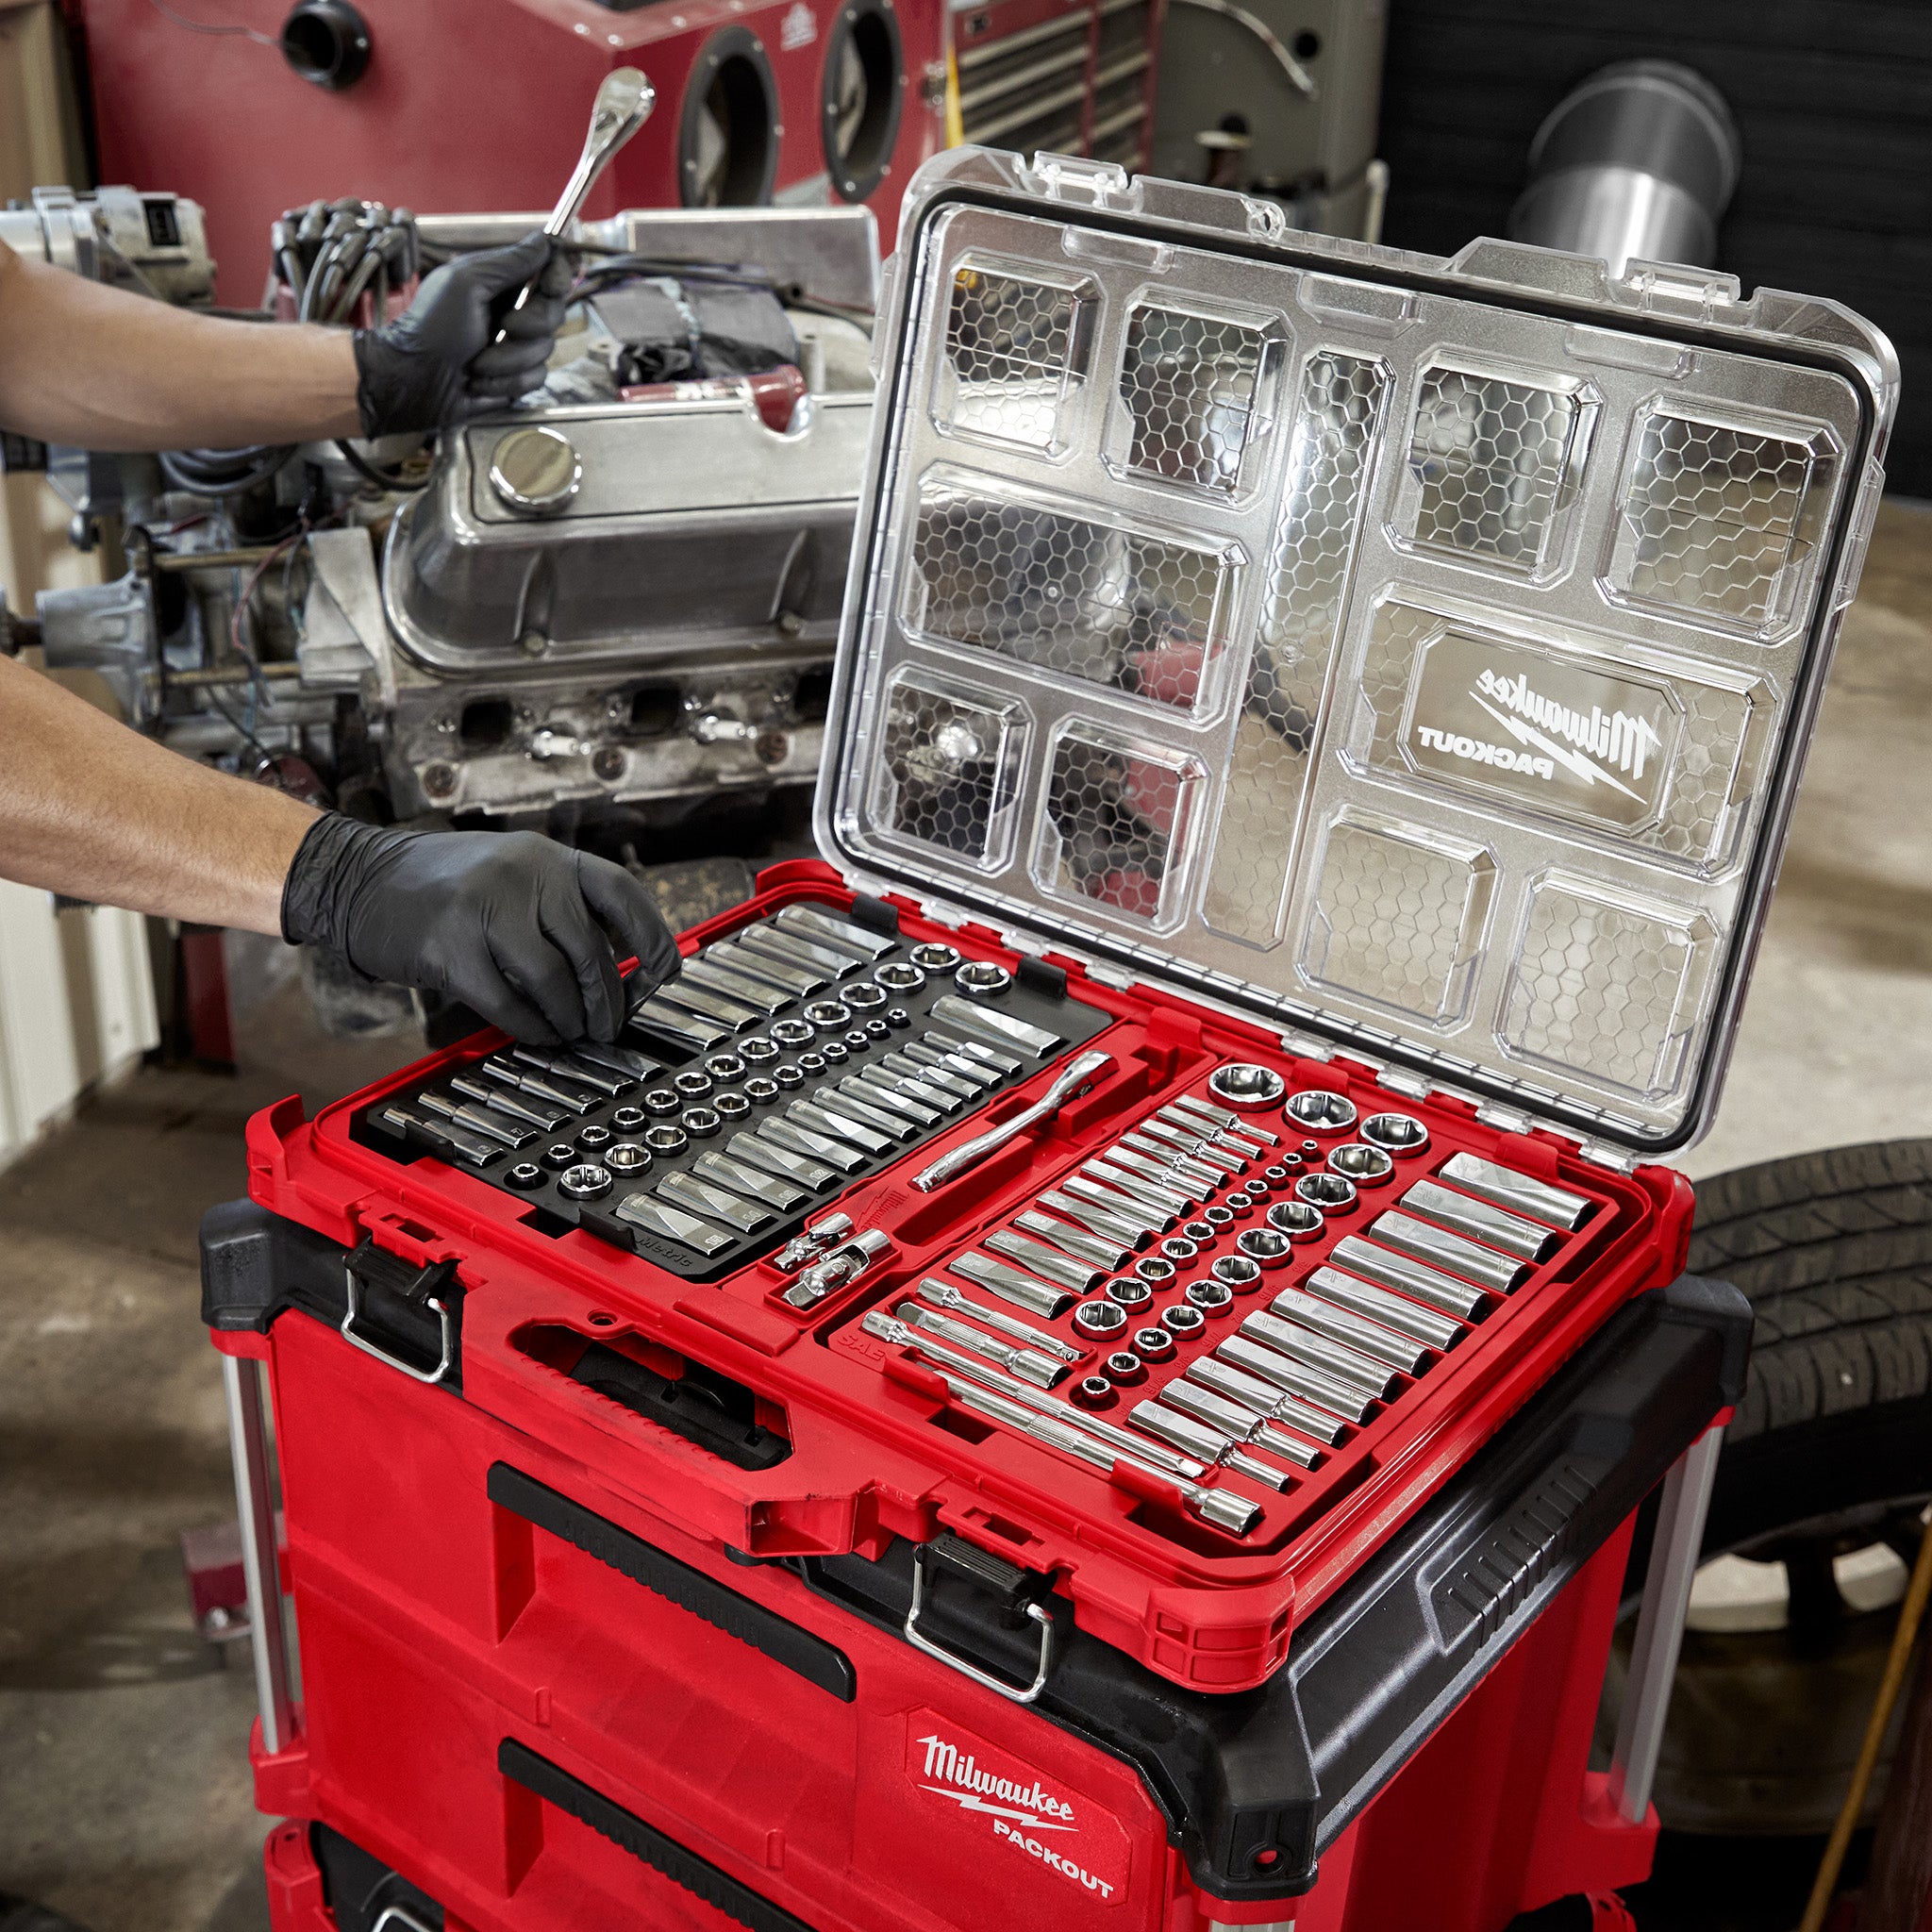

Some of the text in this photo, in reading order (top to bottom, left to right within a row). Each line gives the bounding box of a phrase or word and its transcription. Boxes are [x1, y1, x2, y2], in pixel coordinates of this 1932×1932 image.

[837, 1335, 887, 1361] SAE
[916, 1735, 1074, 1821] Milwaukee
[993, 1818, 1114, 1899] PACKOUT
